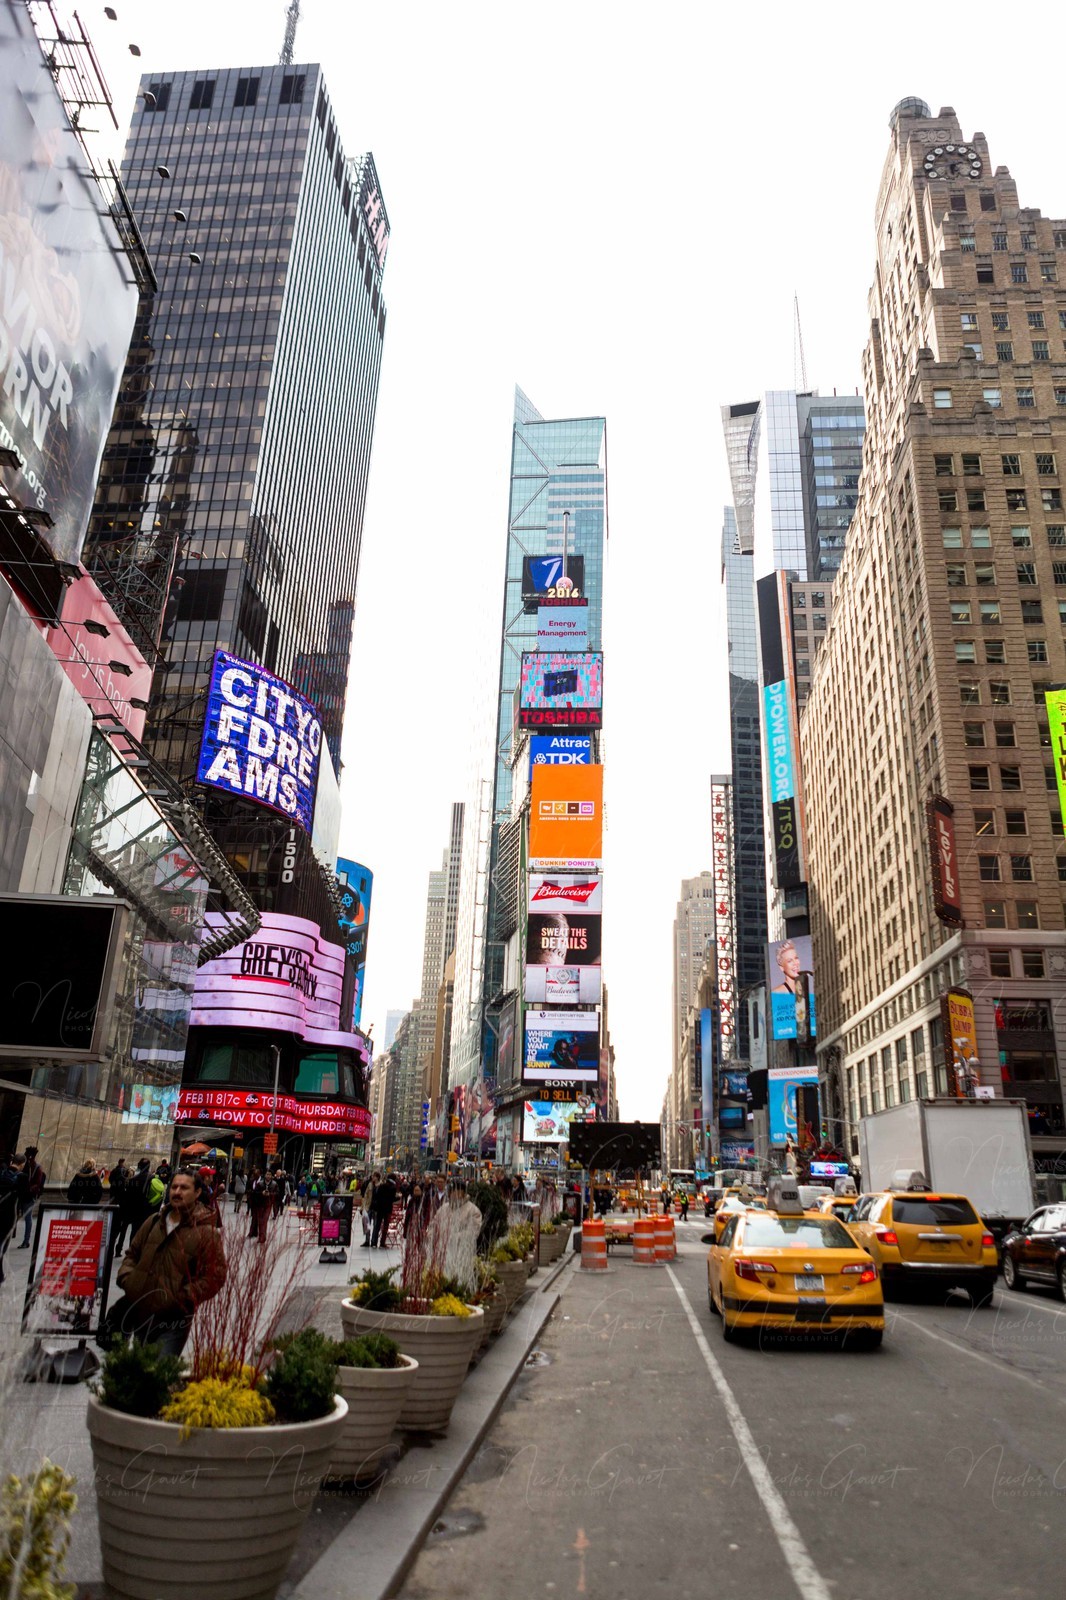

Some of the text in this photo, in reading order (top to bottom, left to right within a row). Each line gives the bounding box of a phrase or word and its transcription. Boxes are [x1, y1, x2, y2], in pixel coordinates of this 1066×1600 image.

[547, 588, 579, 598] 2016
[549, 620, 576, 629] Energy
[537, 630, 588, 638] Management
[223, 654, 255, 672] Welcome
[220, 667, 321, 756] CITYO
[521, 711, 600, 724] TOSHIBA
[217, 703, 315, 789] FDRE
[550, 738, 590, 748] Attrac
[546, 753, 586, 764] TDK
[205, 745, 298, 814] AMS
[281, 828, 297, 884] 1500
[538, 886, 592, 897] Budweiser
[541, 928, 587, 937] SWEAT THE
[541, 937, 587, 949] DETAILS
[241, 942, 302, 983] GREY'S
[185, 1092, 204, 1104] FEB
[245, 1095, 259, 1104] abc
[539, 1089, 549, 1100] TO
[552, 1089, 572, 1100] SELL
[295, 1104, 346, 1117] THURSDAY
[213, 1110, 246, 1123] HOW
[249, 1112, 265, 1124] TO
[304, 1120, 346, 1132] MURDER
